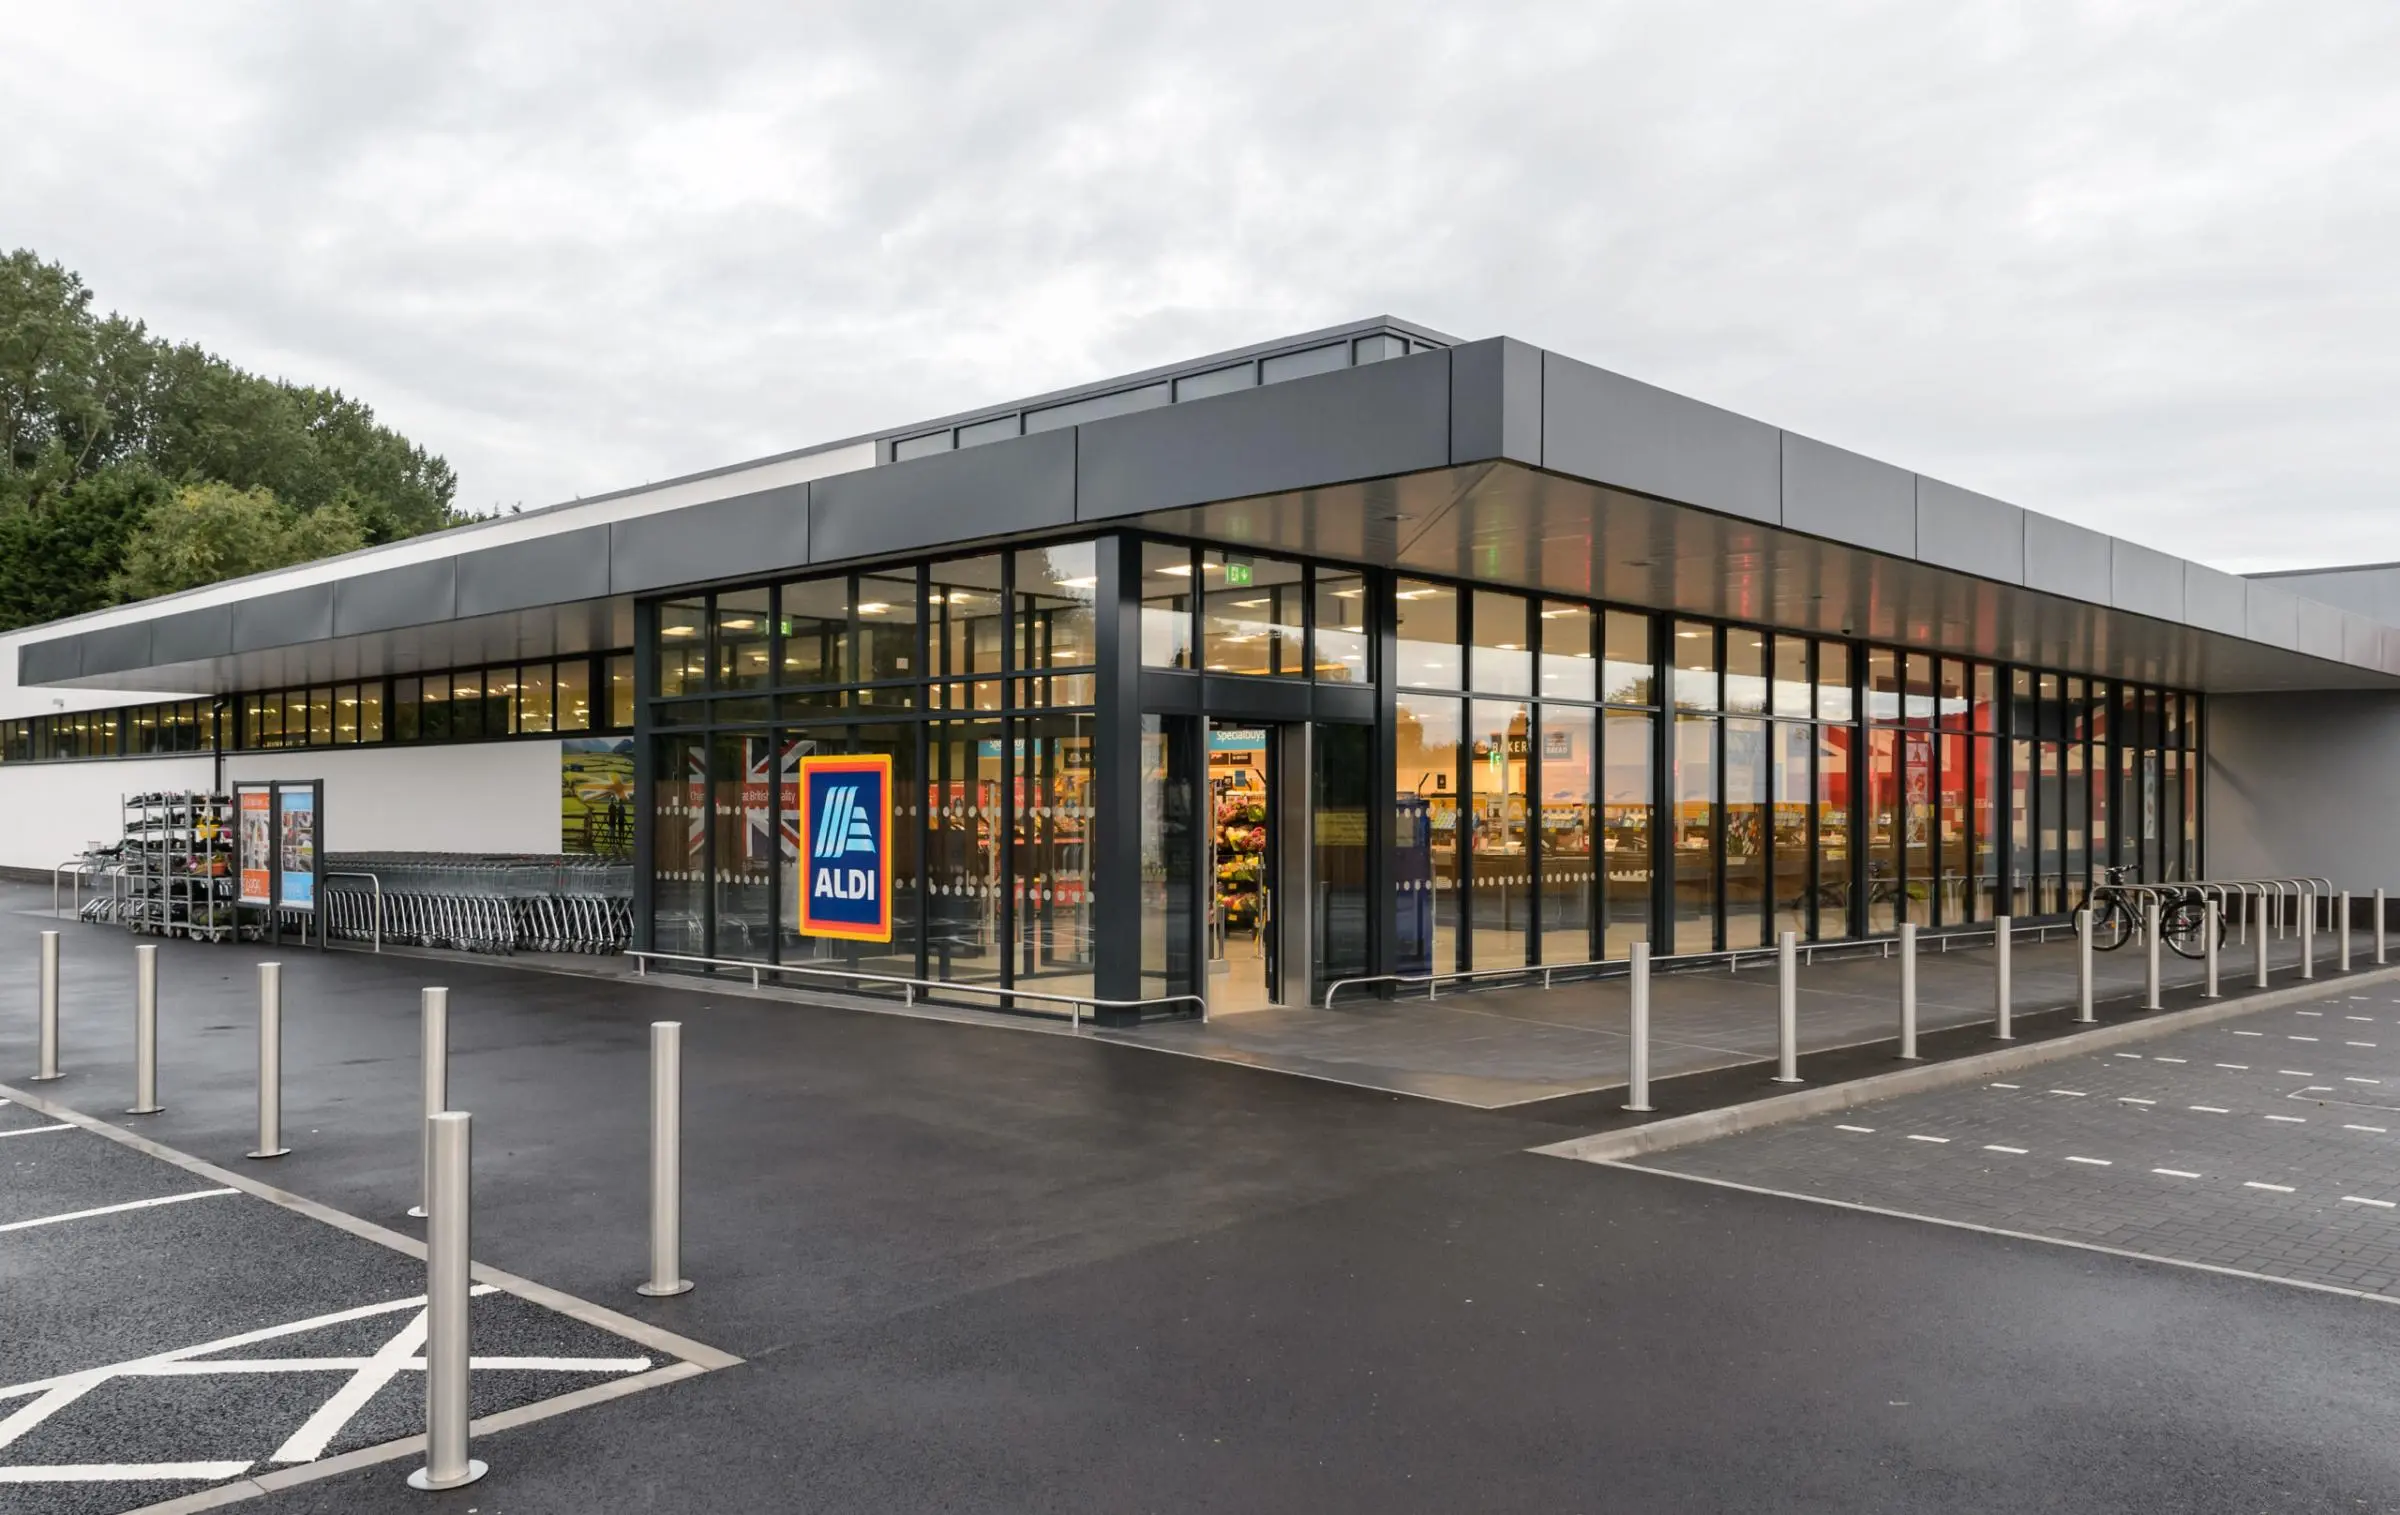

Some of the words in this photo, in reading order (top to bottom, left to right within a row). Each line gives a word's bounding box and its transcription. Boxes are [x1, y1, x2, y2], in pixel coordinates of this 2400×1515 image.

[1216, 730, 1266, 744] Specialbuys
[781, 789, 796, 804] ality
[814, 867, 875, 901] ALDI
